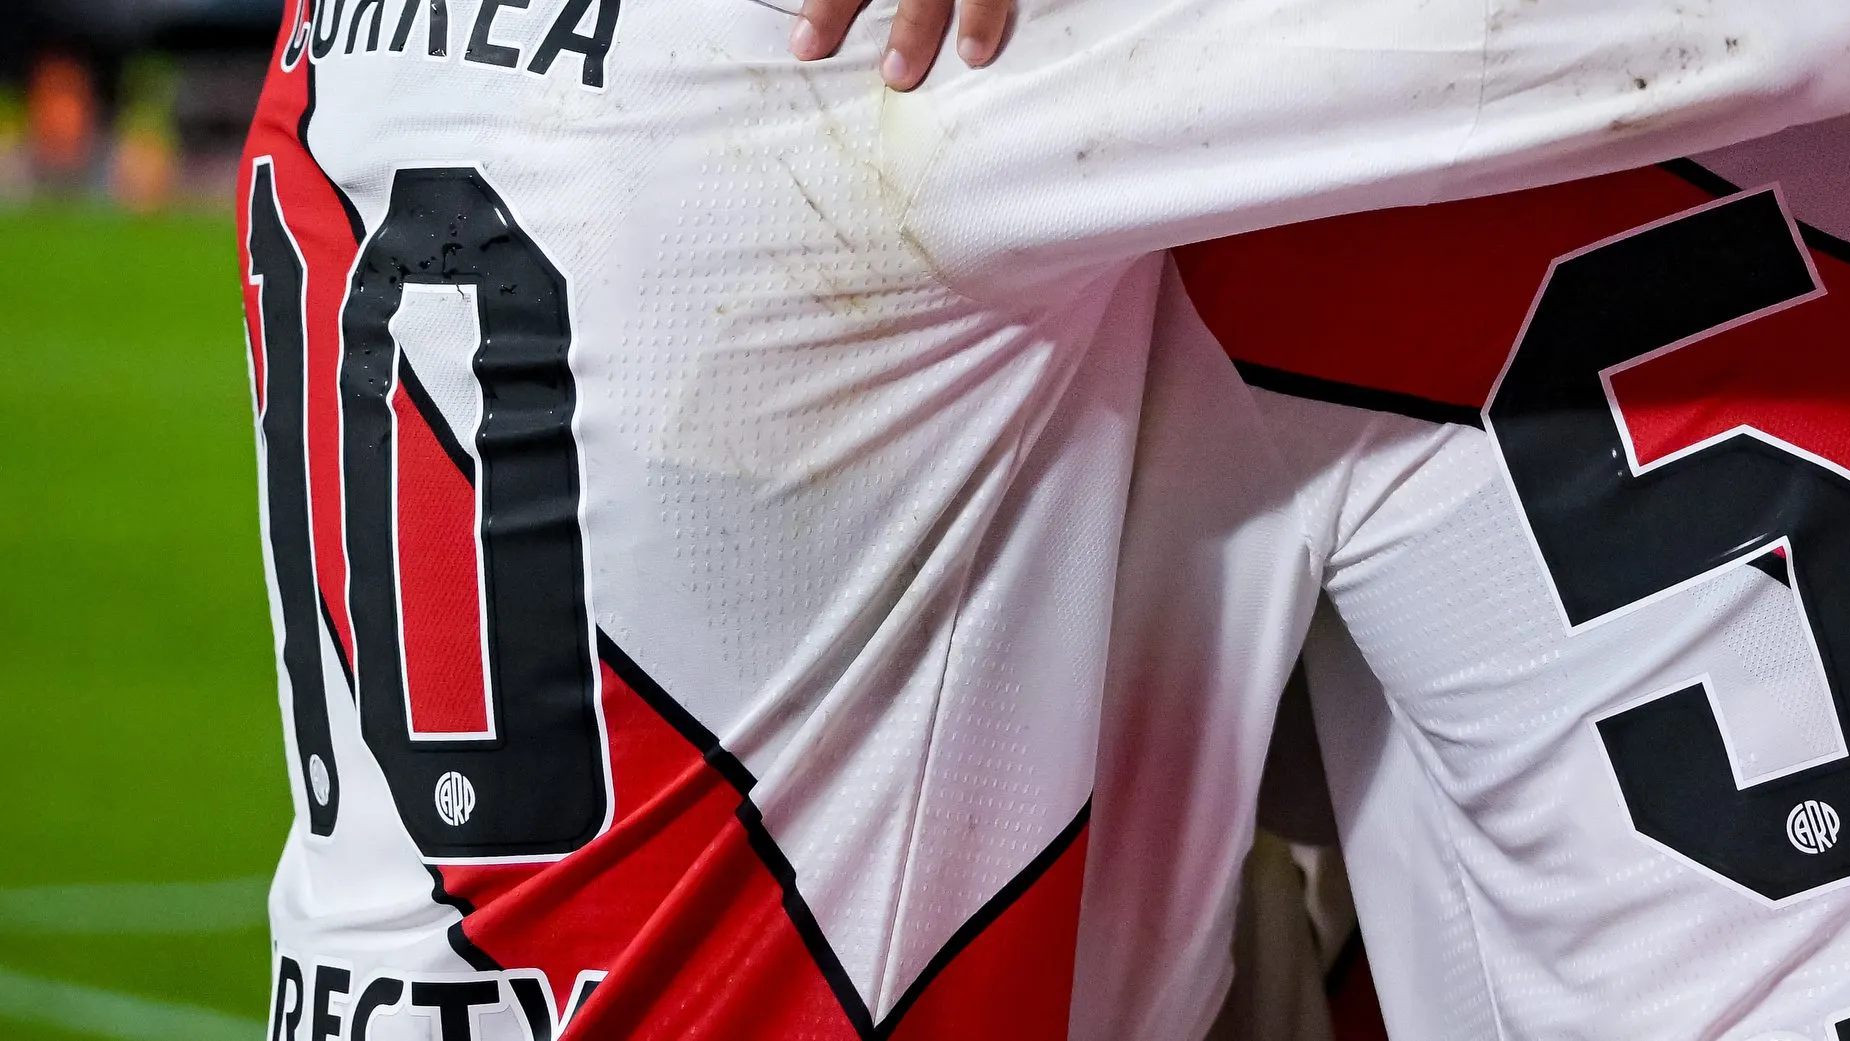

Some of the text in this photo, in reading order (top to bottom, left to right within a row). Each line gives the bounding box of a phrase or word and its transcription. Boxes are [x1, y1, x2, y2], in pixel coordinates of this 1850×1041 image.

[246, 155, 616, 865] 10
[434, 770, 476, 827] CARP
[1785, 798, 1841, 855] CARP
